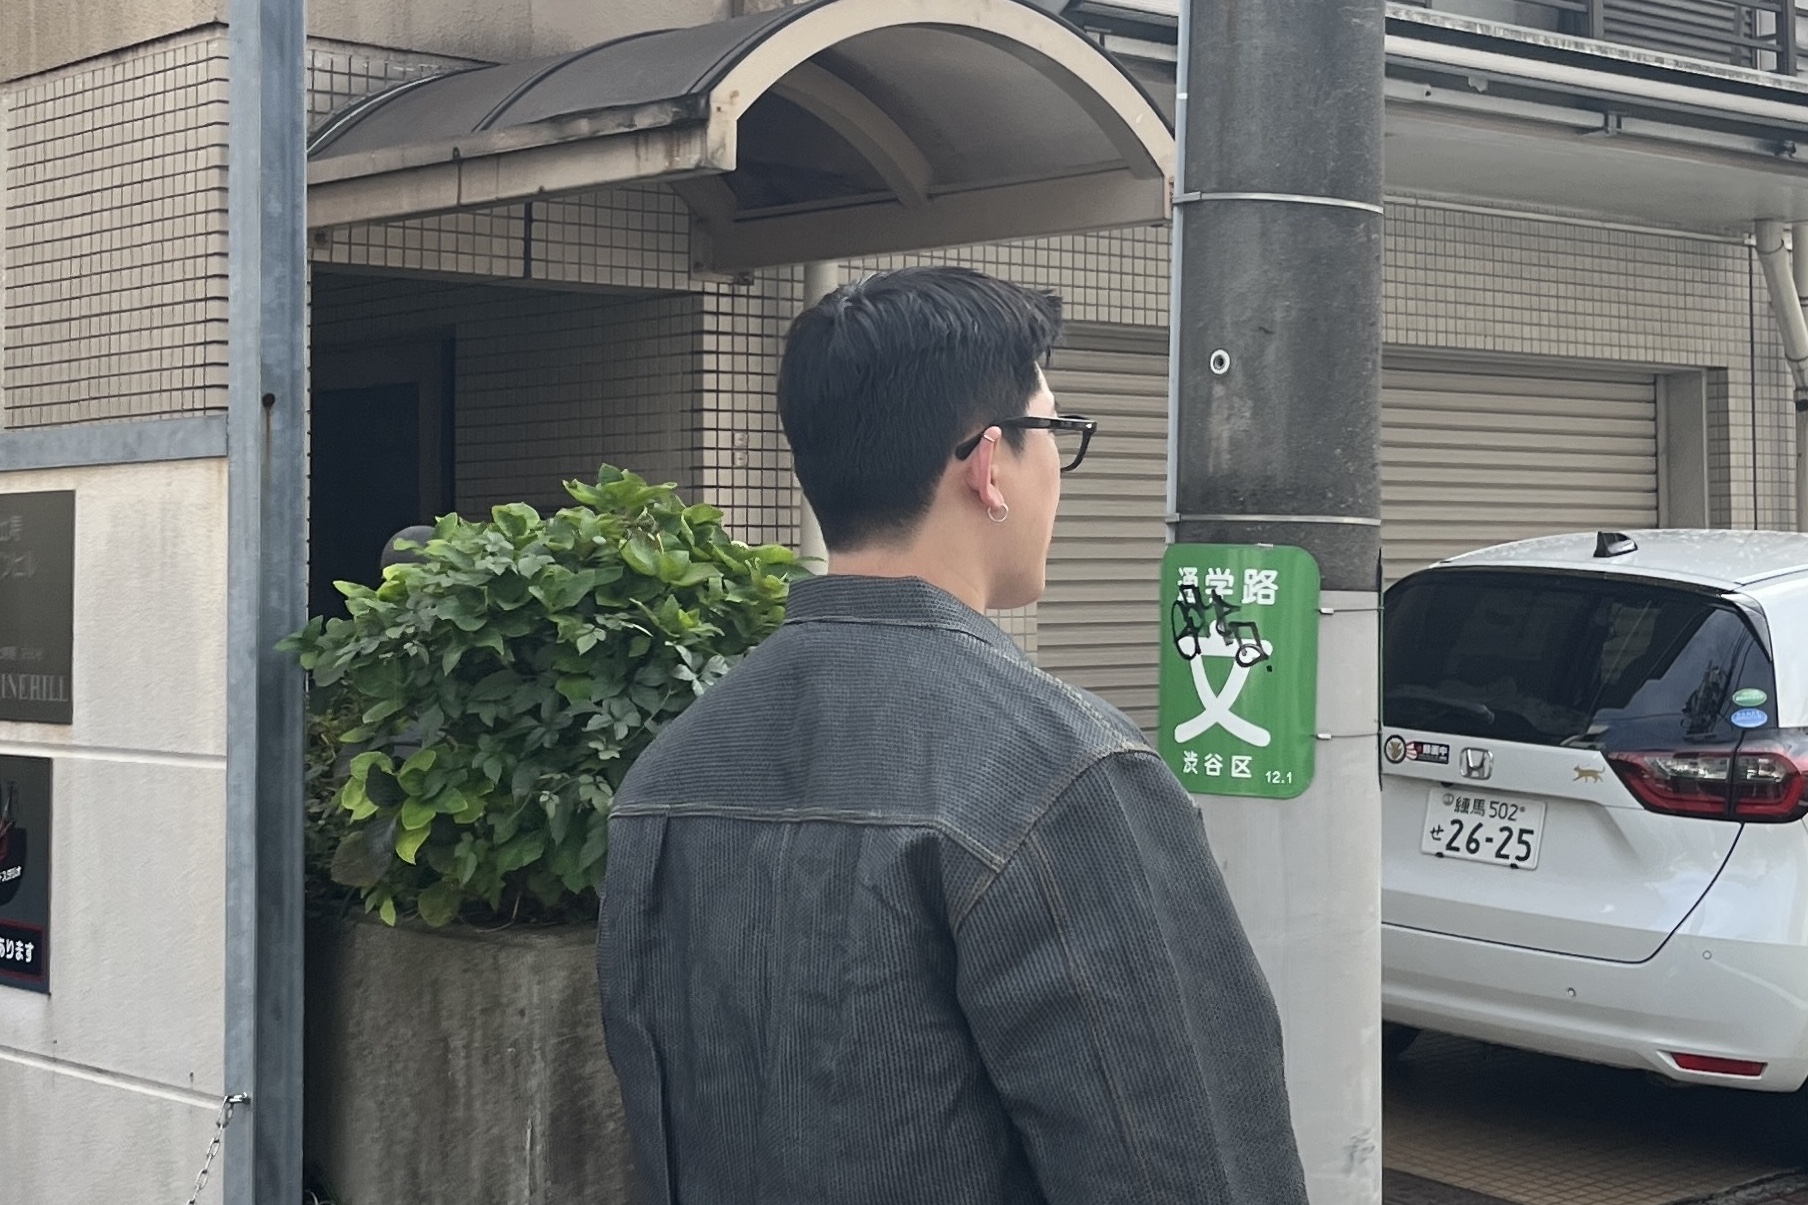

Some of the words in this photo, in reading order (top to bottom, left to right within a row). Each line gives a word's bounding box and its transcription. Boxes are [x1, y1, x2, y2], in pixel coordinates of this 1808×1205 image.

[1178, 567, 1278, 605] 通学路
[1182, 751, 1252, 778] 渋谷区
[1265, 770, 1293, 785] 12.1
[1454, 796, 1486, 817] 練馬
[1489, 801, 1519, 821] 502
[1430, 824, 1445, 841] せ
[1445, 819, 1535, 862] 26-25
